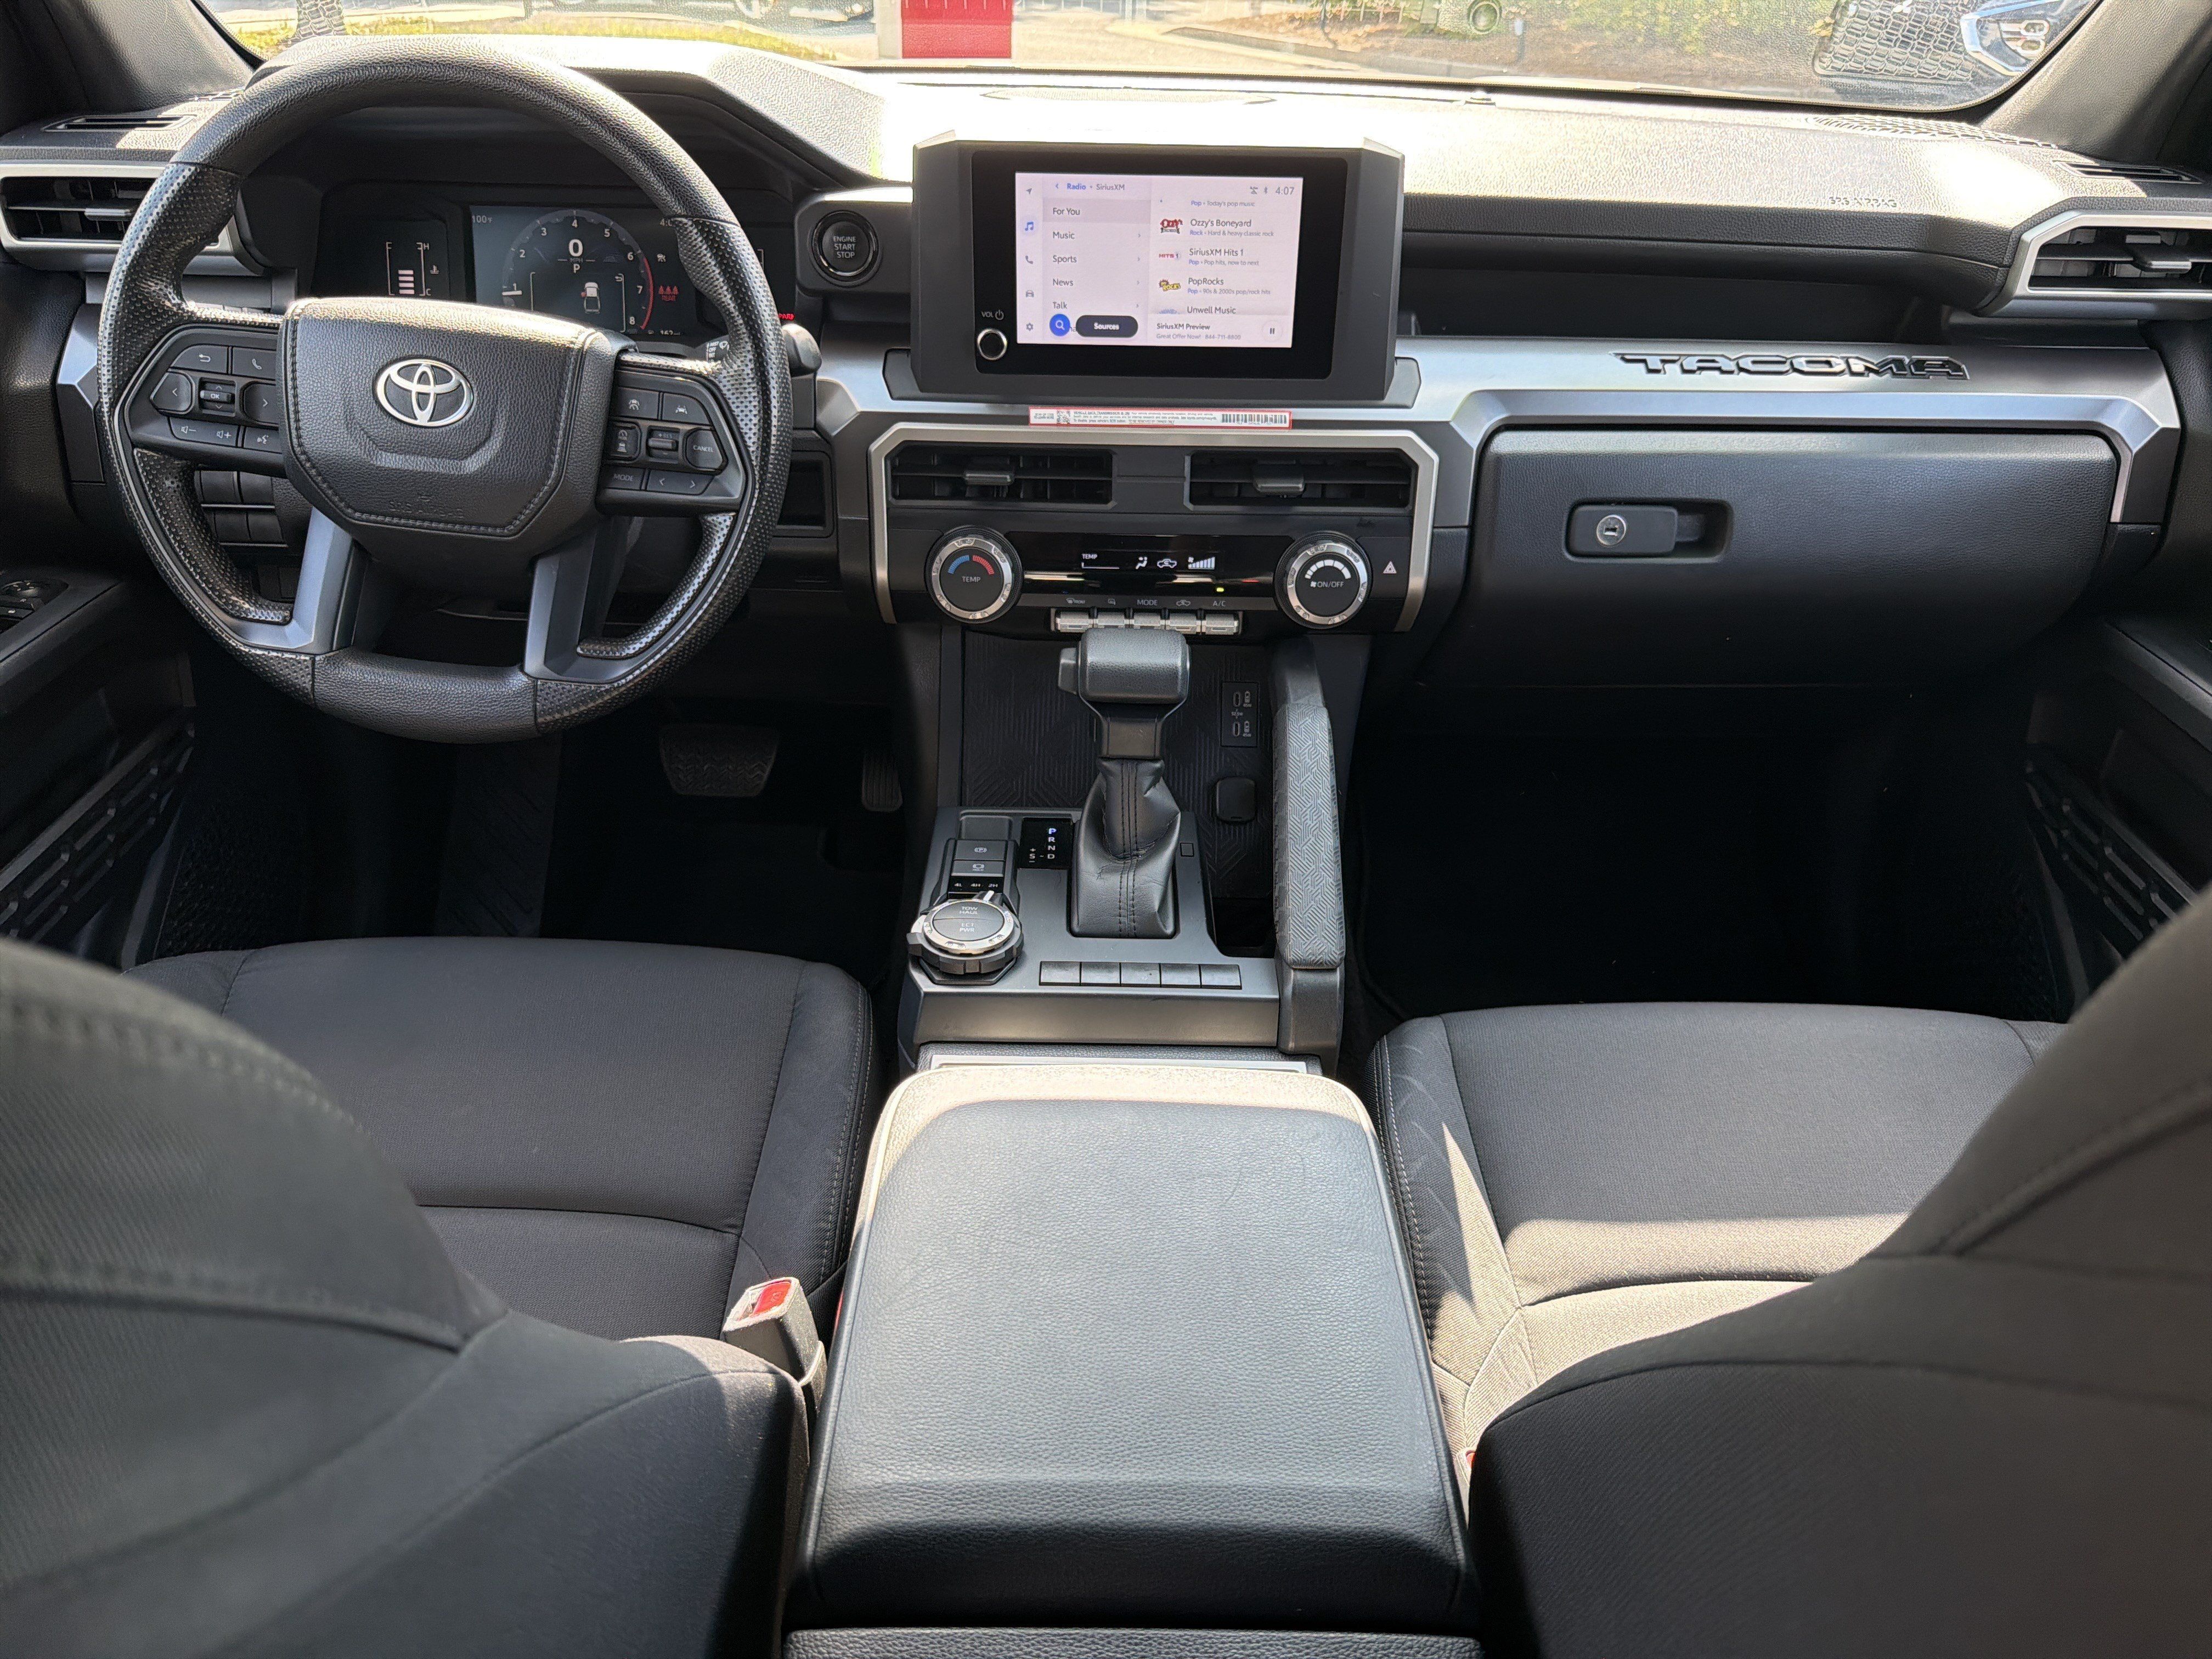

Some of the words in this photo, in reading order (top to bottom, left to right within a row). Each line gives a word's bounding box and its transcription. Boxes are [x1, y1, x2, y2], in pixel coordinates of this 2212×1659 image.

[572, 219, 578, 228] 4
[1190, 219, 1215, 228] Ozzy's
[541, 227, 547, 236] 3
[604, 229, 610, 238] 5
[569, 239, 583, 257] 0
[520, 249, 526, 258] 2
[627, 252, 634, 261] 6
[1052, 255, 1077, 264] Sports
[573, 263, 580, 273] P
[512, 282, 517, 291] 1
[1188, 278, 1224, 286] PopRocks
[426, 288, 431, 296] C
[636, 285, 643, 294] 7
[1187, 306, 1214, 314] Unwell
[629, 316, 635, 325] 8
[1609, 352, 1970, 381] TACOMA
[614, 473, 633, 482] MODE
